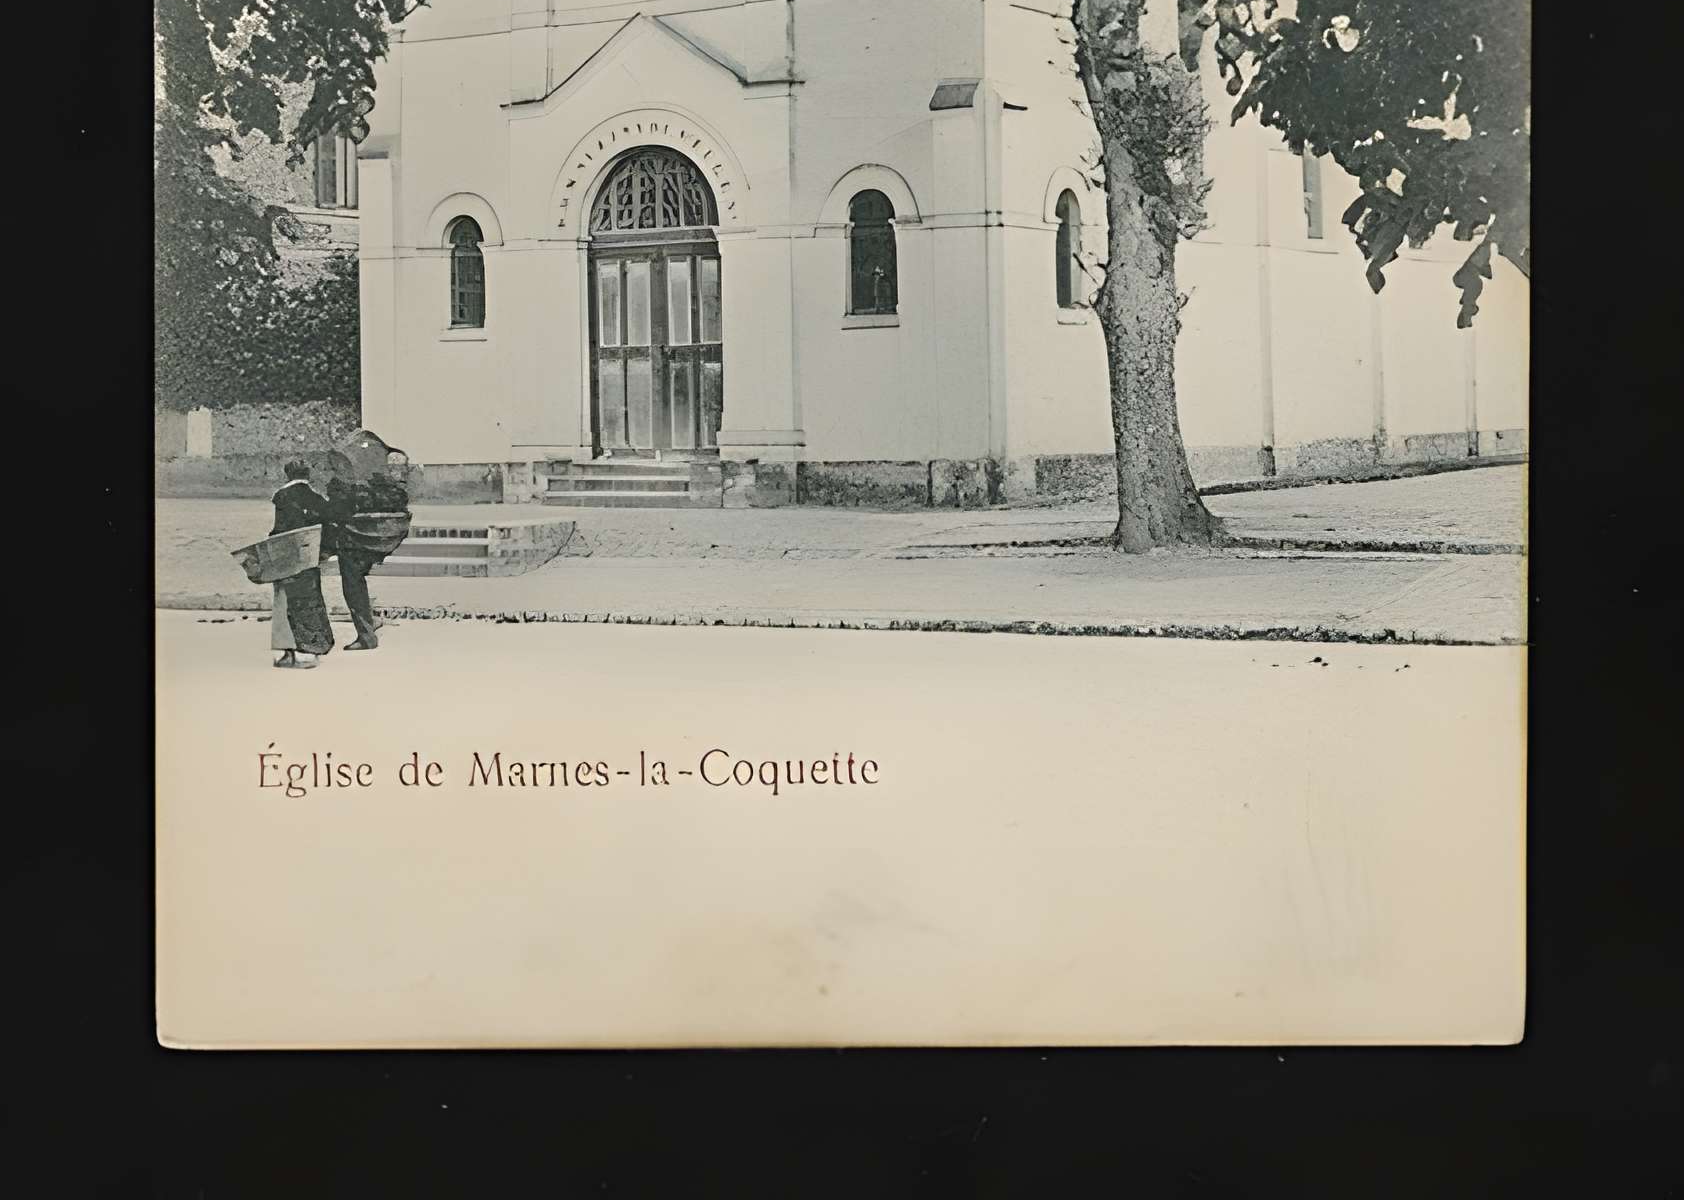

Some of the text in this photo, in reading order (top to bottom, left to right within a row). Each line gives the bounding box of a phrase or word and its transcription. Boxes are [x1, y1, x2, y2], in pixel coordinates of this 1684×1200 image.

[257, 741, 878, 798] Église de Marnes-la-Coquette
